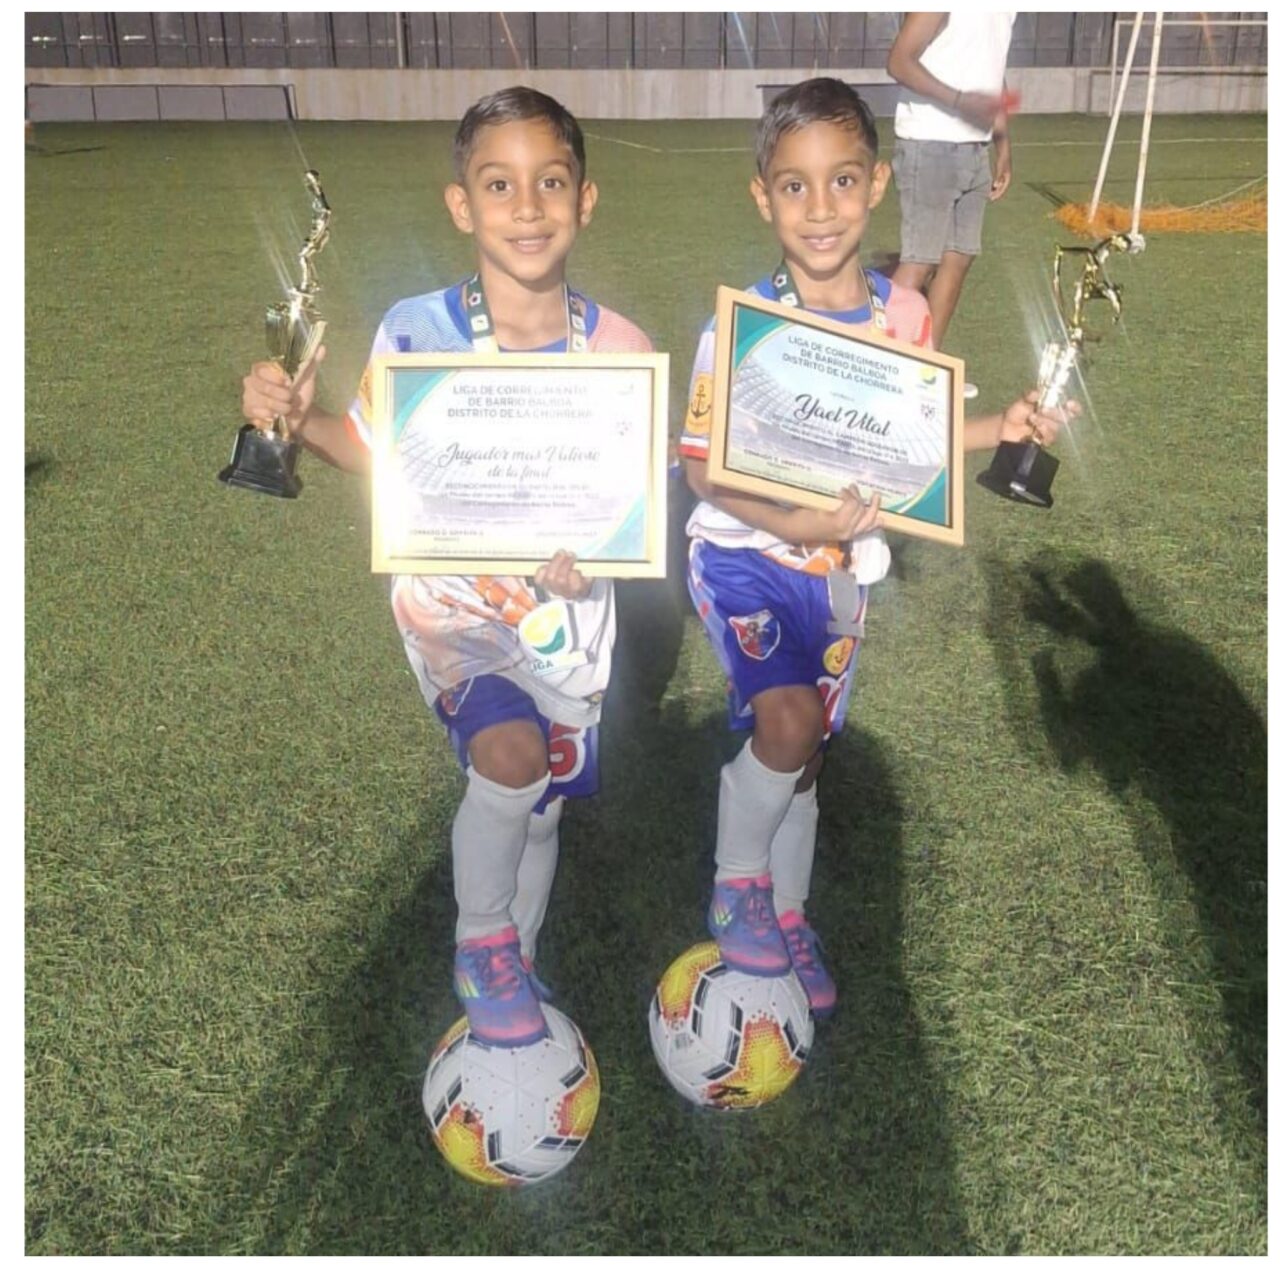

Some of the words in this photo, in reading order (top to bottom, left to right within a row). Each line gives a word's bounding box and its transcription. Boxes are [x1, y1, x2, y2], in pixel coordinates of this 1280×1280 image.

[788, 335, 809, 348] LIGA
[811, 342, 822, 352] DE
[825, 346, 900, 375] CORREGIMIENTO
[801, 348, 812, 359] DE
[815, 352, 850, 369] BARRIO
[851, 363, 887, 381] BALBOA
[452, 384, 478, 396] LIGA
[480, 384, 495, 396] DE
[782, 352, 825, 373] DISTRITO
[826, 367, 840, 377] DE
[841, 370, 853, 381] LA
[854, 375, 904, 395] CHORRERA
[447, 408, 497, 418] DISTRITO
[499, 408, 515, 418] DE
[467, 396, 483, 407] DE
[485, 396, 526, 407] BARRIO
[793, 393, 843, 423] Yael
[844, 409, 891, 437] Vital
